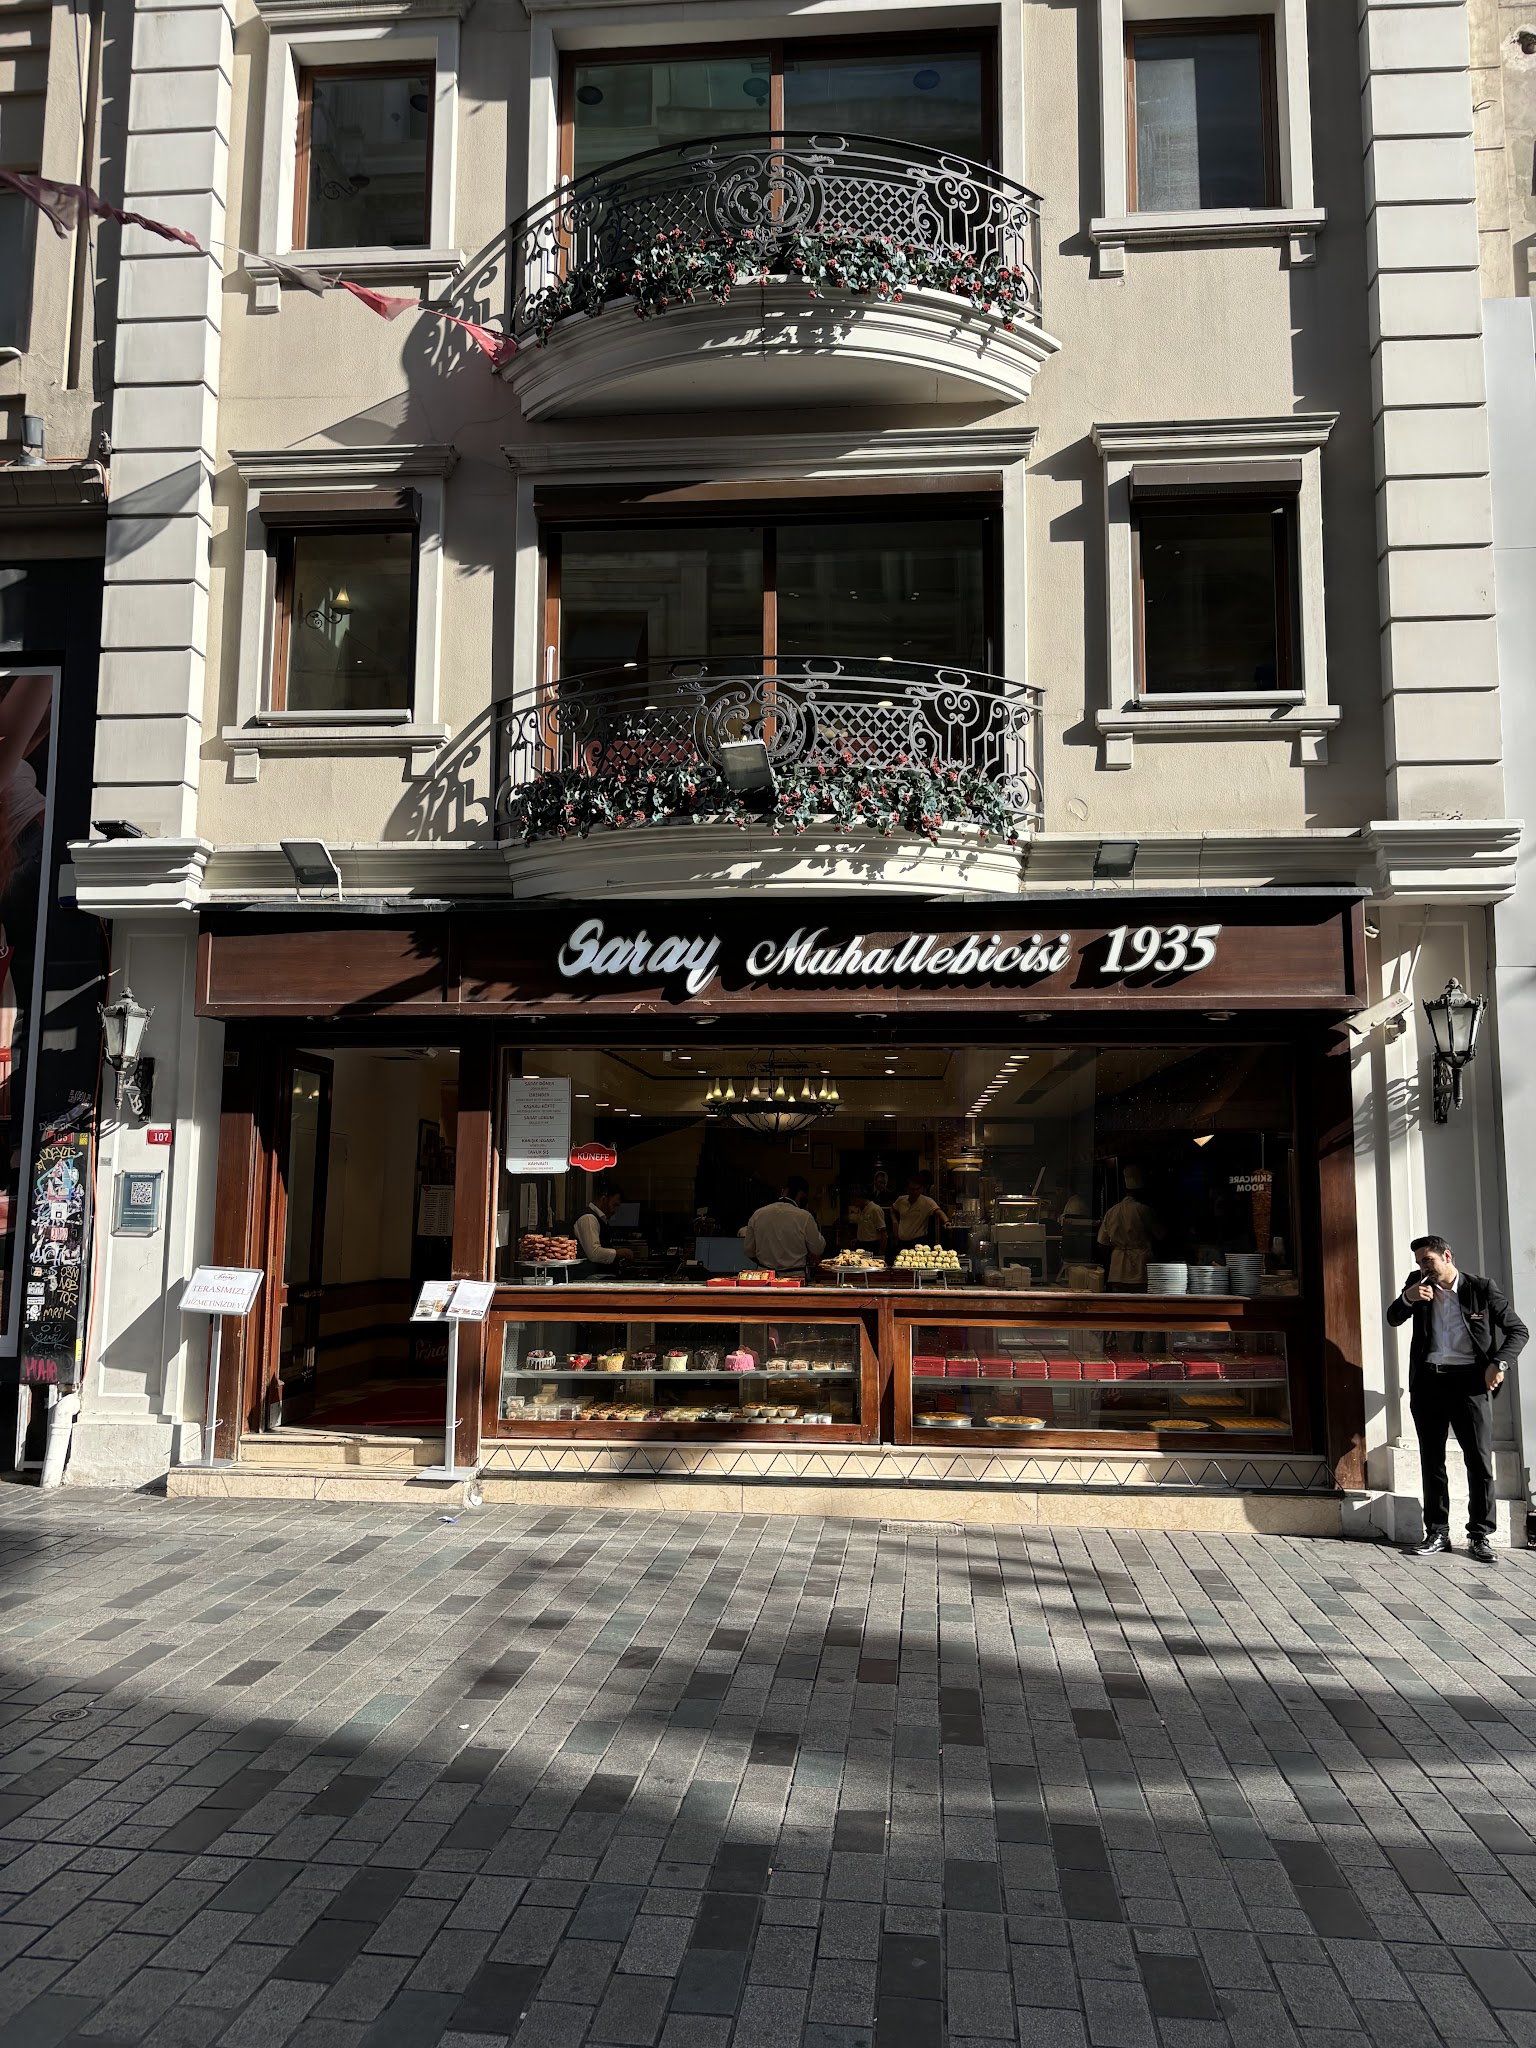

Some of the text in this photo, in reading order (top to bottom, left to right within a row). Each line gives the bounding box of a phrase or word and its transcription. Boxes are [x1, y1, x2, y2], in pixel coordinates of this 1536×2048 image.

[558, 918, 1222, 995] Saray Muhallebicisi 1935
[153, 1132, 169, 1142] 107
[577, 1151, 610, 1162] KÜNEFE
